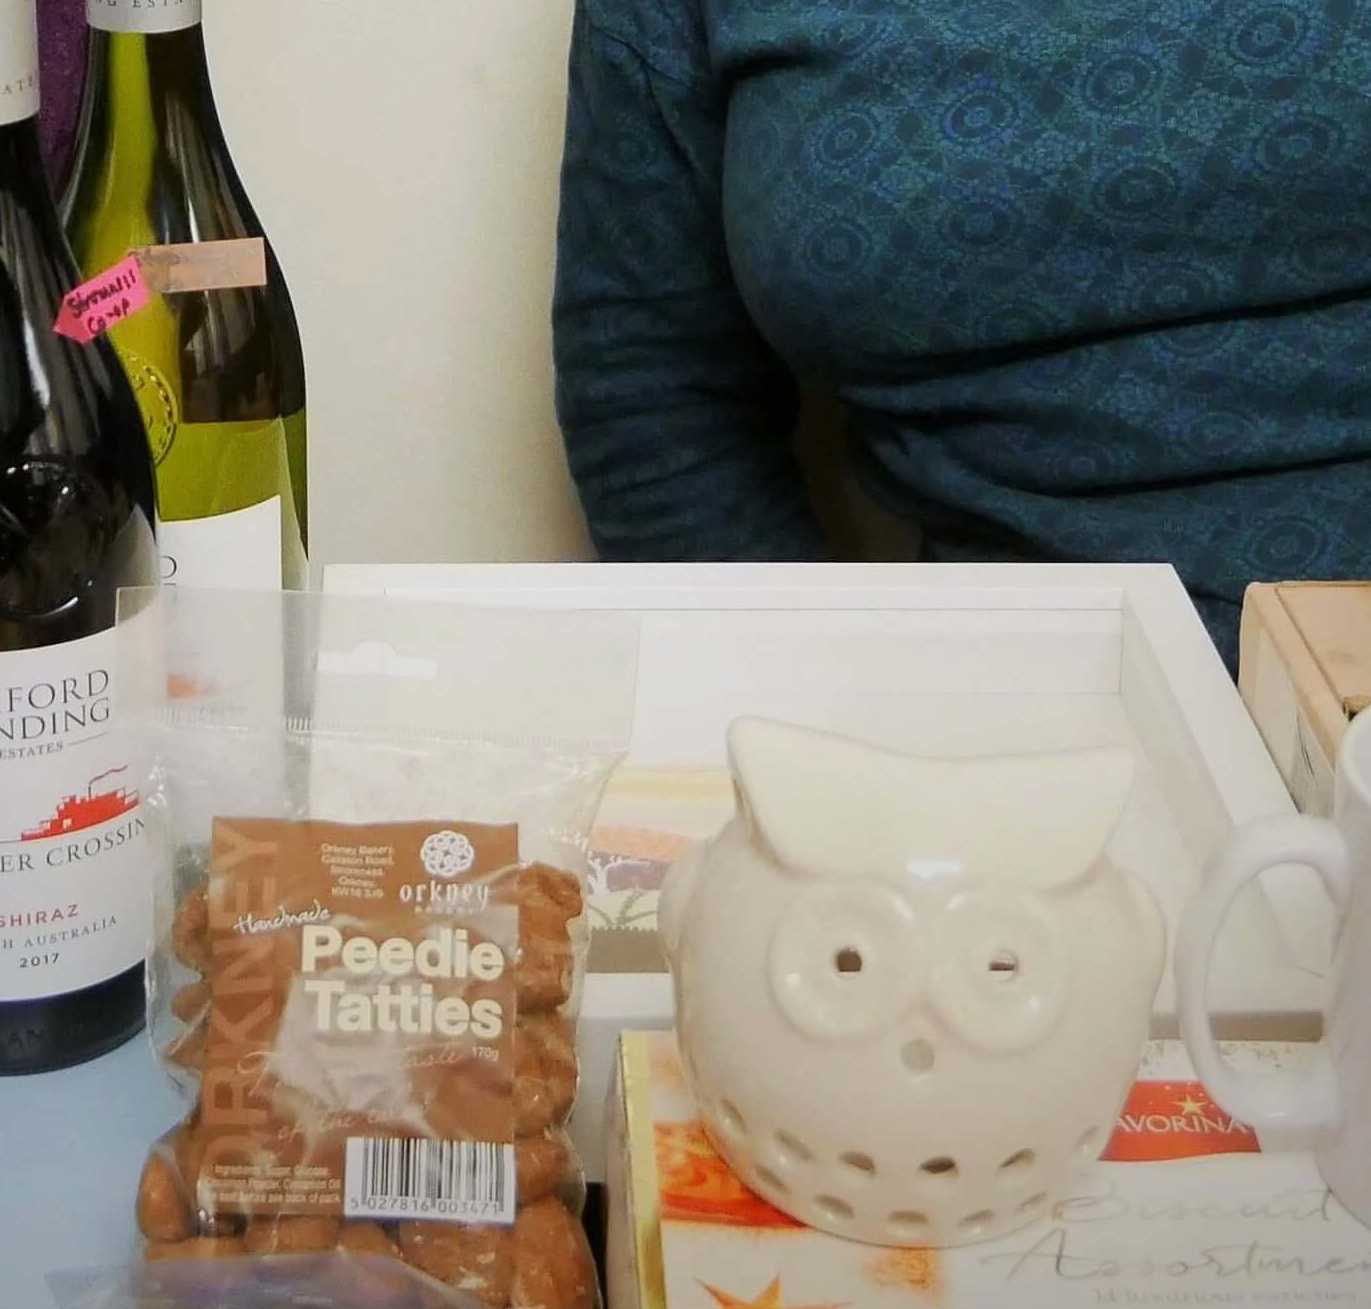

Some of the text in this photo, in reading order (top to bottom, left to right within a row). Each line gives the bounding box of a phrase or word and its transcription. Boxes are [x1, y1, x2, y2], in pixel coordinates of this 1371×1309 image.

[398, 879, 490, 910] orkney
[23, 914, 118, 949] AUSTRALIA
[232, 899, 332, 934] Handmade
[18, 952, 60, 969] 2017
[301, 924, 505, 981] Peedie
[304, 979, 504, 1039] Tatties
[471, 1045, 500, 1062] 170g
[350, 1197, 358, 1210] 5
[366, 1198, 430, 1212] 027816
